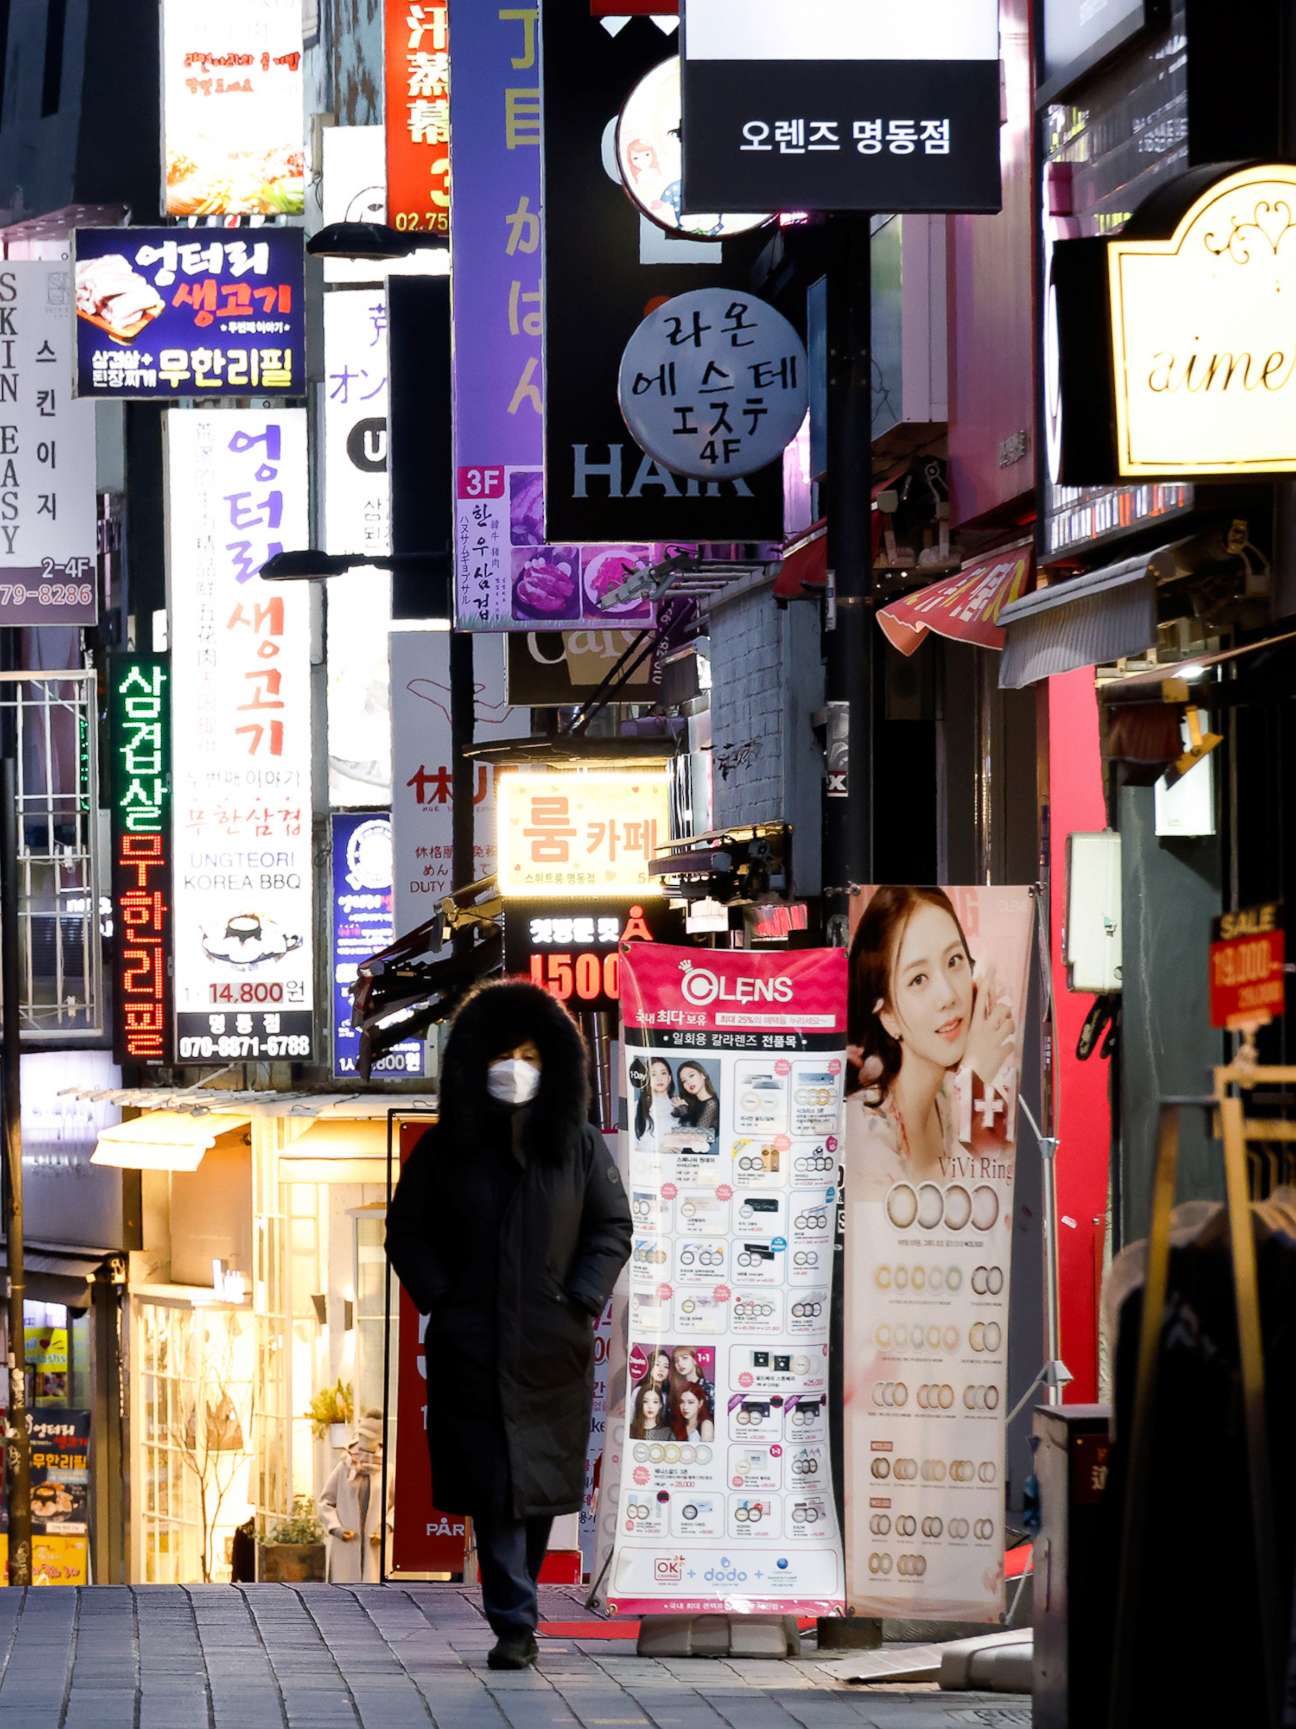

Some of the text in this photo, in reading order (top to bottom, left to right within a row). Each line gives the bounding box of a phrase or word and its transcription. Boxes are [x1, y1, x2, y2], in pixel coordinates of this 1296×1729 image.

[739, 118, 951, 154] 오렌즈 명동점
[135, 240, 270, 287] 엉터리
[171, 278, 292, 328] 생고기
[663, 301, 758, 348] 라온
[158, 347, 292, 388] 무한리필
[632, 355, 798, 397] 에스테
[35, 340, 58, 521] 스킨이지
[672, 397, 769, 436] エステ
[699, 438, 742, 465] 4F
[0, 425, 20, 555] EASY
[465, 469, 500, 496] 3F
[223, 424, 284, 584] 엉터리
[41, 557, 90, 580] 2-4F
[226, 596, 285, 756] 생고기
[118, 665, 168, 832] 삼겹살
[523, 796, 658, 863] 룸 카페
[183, 873, 302, 890] KOREA BBQ
[409, 880, 445, 893] DUTY
[1220, 905, 1276, 940] SALE
[119, 832, 168, 1056] 무한리필
[680, 966, 794, 1006] OLENS
[672, 1031, 797, 1048] 일회용 칼라렌즈 전품목
[938, 1156, 1014, 1185] ViVi Ring
[657, 1562, 679, 1574] OK
[703, 1568, 748, 1582] dodo
